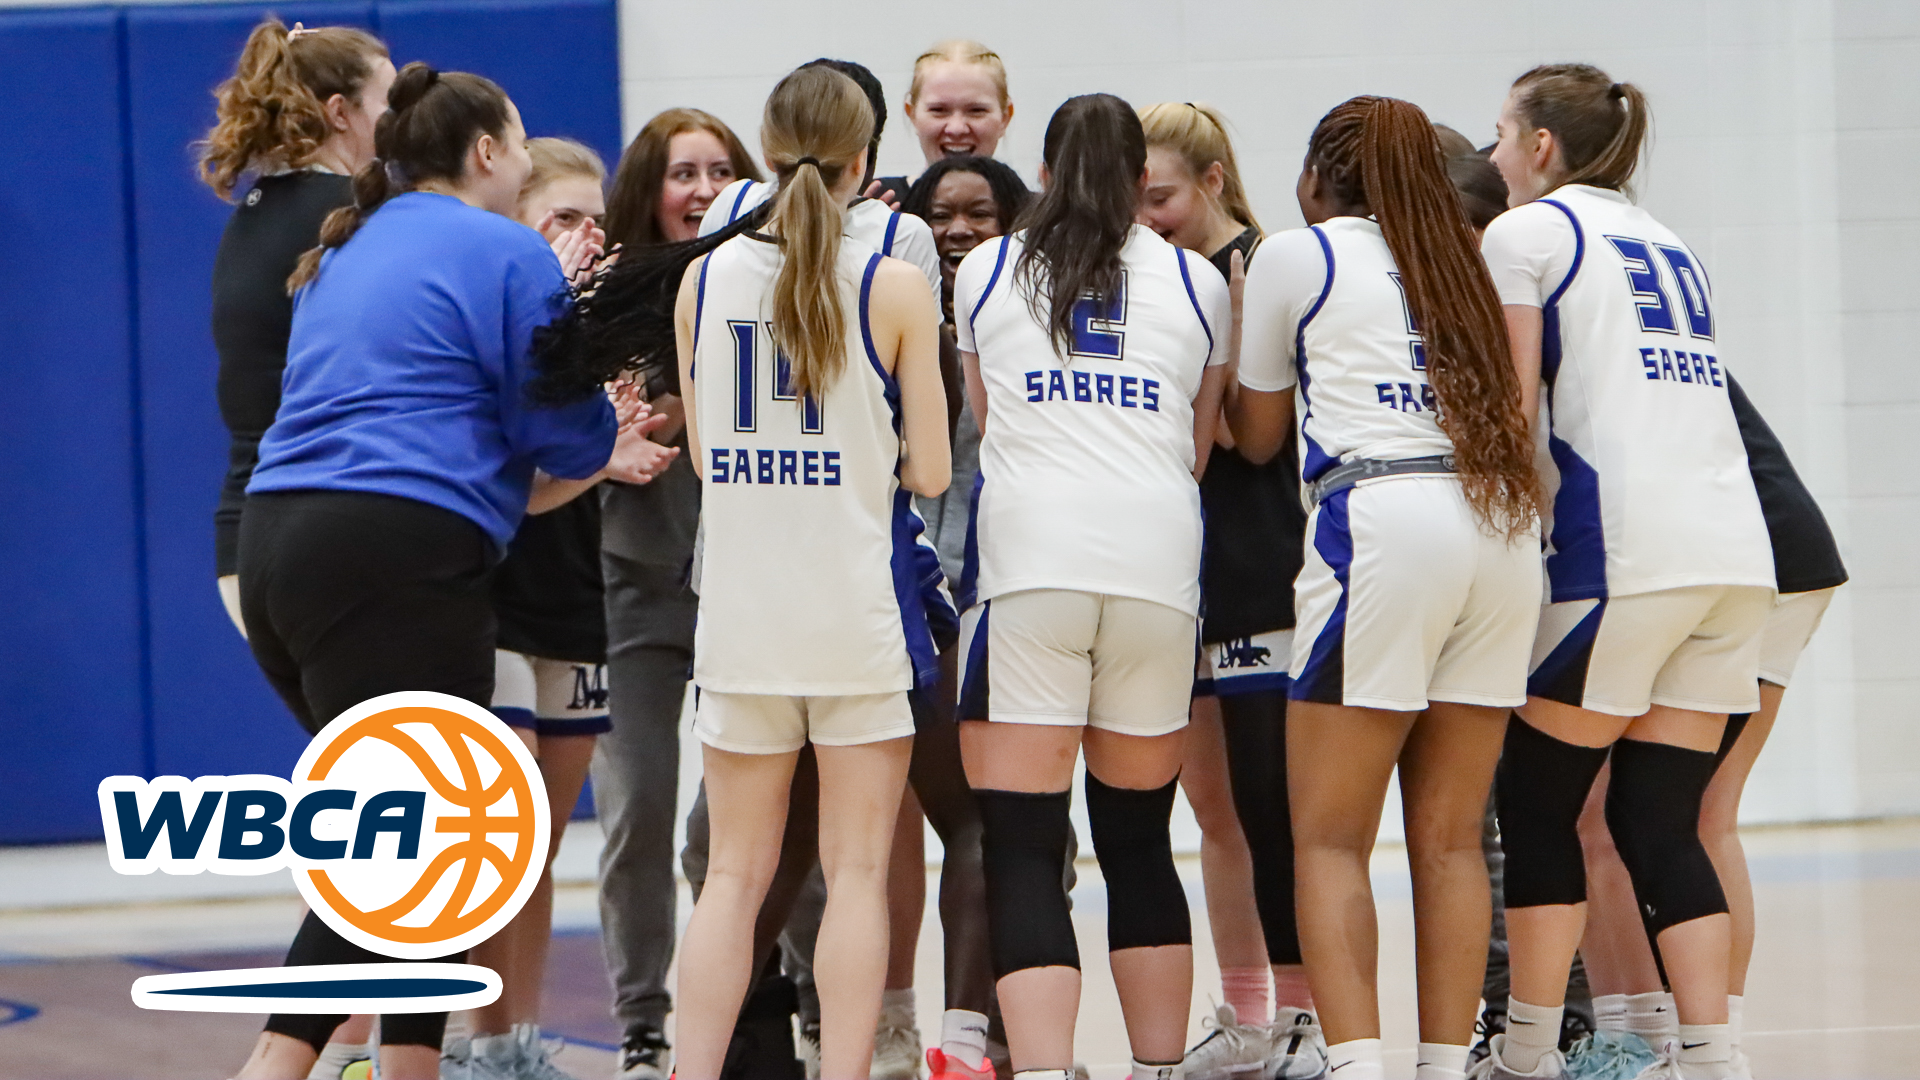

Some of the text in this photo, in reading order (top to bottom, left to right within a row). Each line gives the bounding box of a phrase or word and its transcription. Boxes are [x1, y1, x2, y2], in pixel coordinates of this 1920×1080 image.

[1602, 234, 1715, 343] 30
[1067, 269, 1128, 361] 2
[1638, 347, 1724, 388] SABRE
[1025, 369, 1160, 413] SABRES
[1374, 382, 1438, 413] SAB
[711, 448, 841, 487] SABRES
